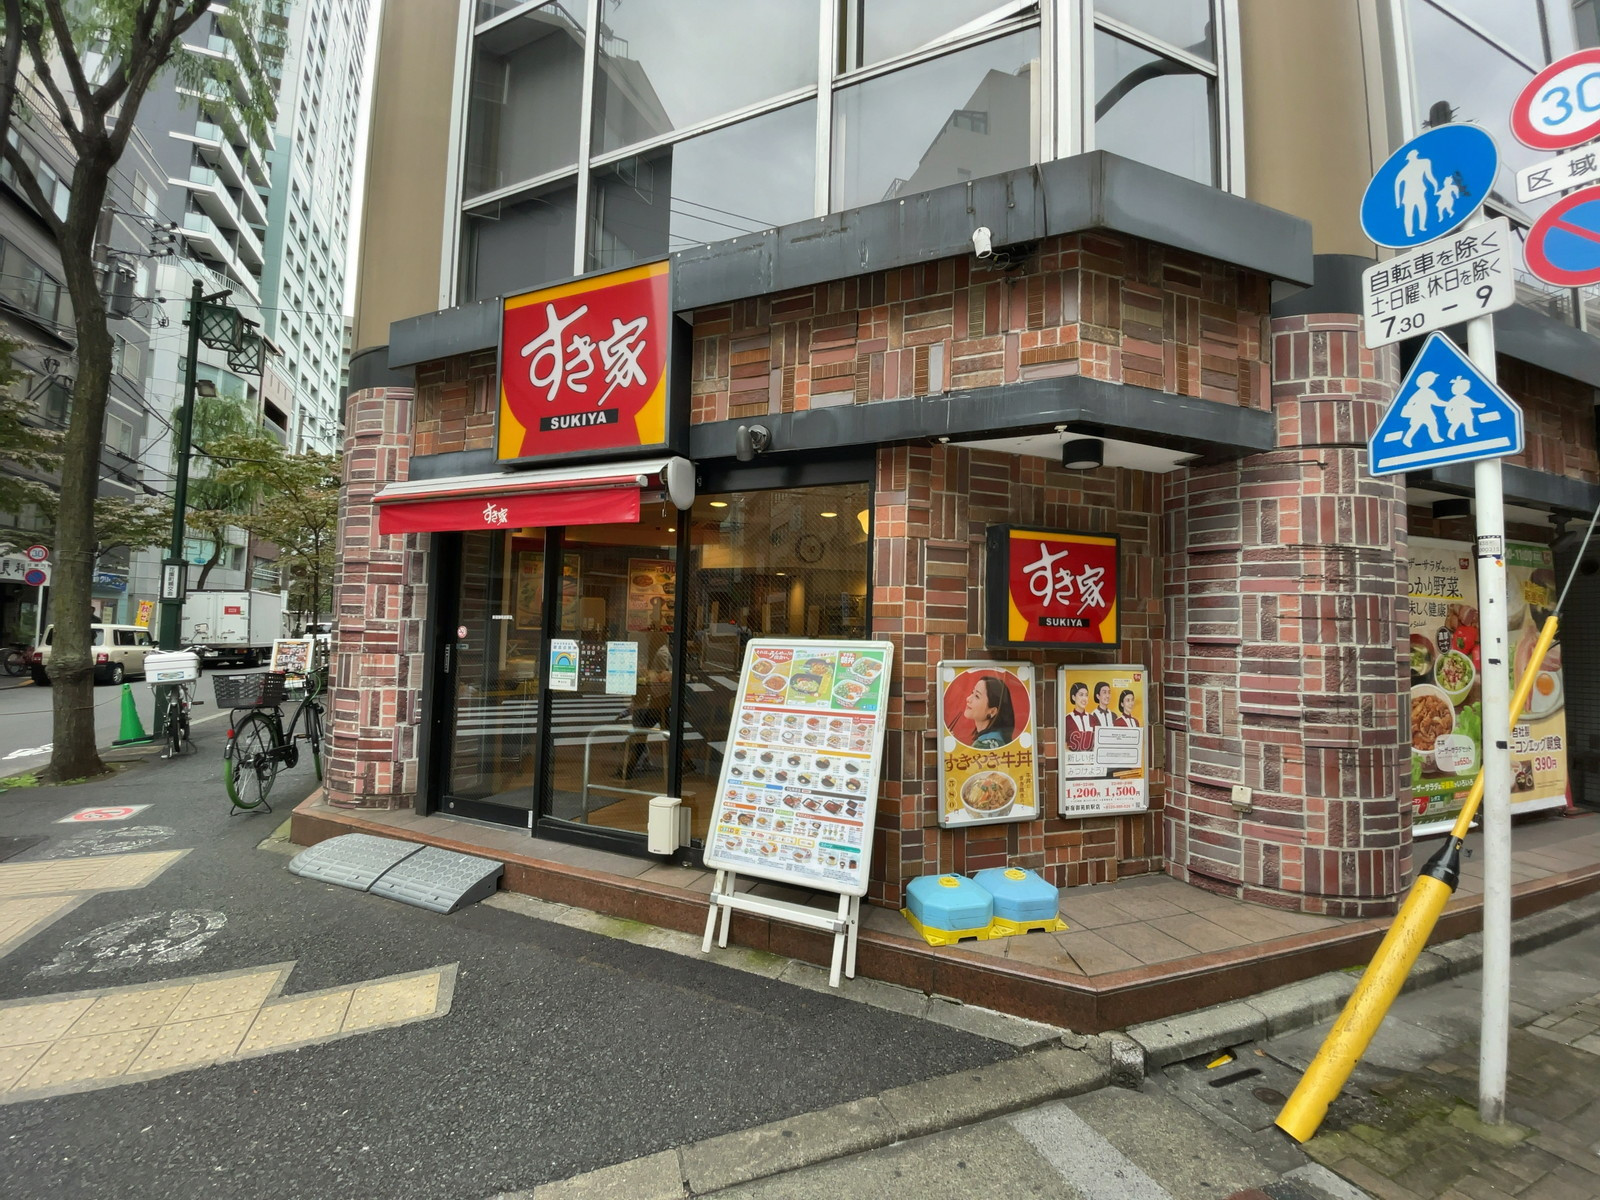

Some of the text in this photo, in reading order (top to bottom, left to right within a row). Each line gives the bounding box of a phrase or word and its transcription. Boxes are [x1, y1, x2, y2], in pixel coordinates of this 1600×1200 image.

[1541, 72, 1600, 126] 30
[1527, 152, 1598, 193] 区域
[1370, 231, 1498, 292] 自転車を除く
[1380, 312, 1425, 339] 7.30
[1475, 285, 1493, 308] 9
[521, 303, 648, 407] すき家
[550, 411, 608, 430] SUKIYA
[483, 502, 509, 526] すき家
[31, 549, 44, 558] 30
[1022, 542, 1105, 616] すき家
[1046, 617, 1083, 627] SUKIYA
[944, 751, 1033, 772] すきやき牛丼
[1535, 755, 1557, 772] 390円
